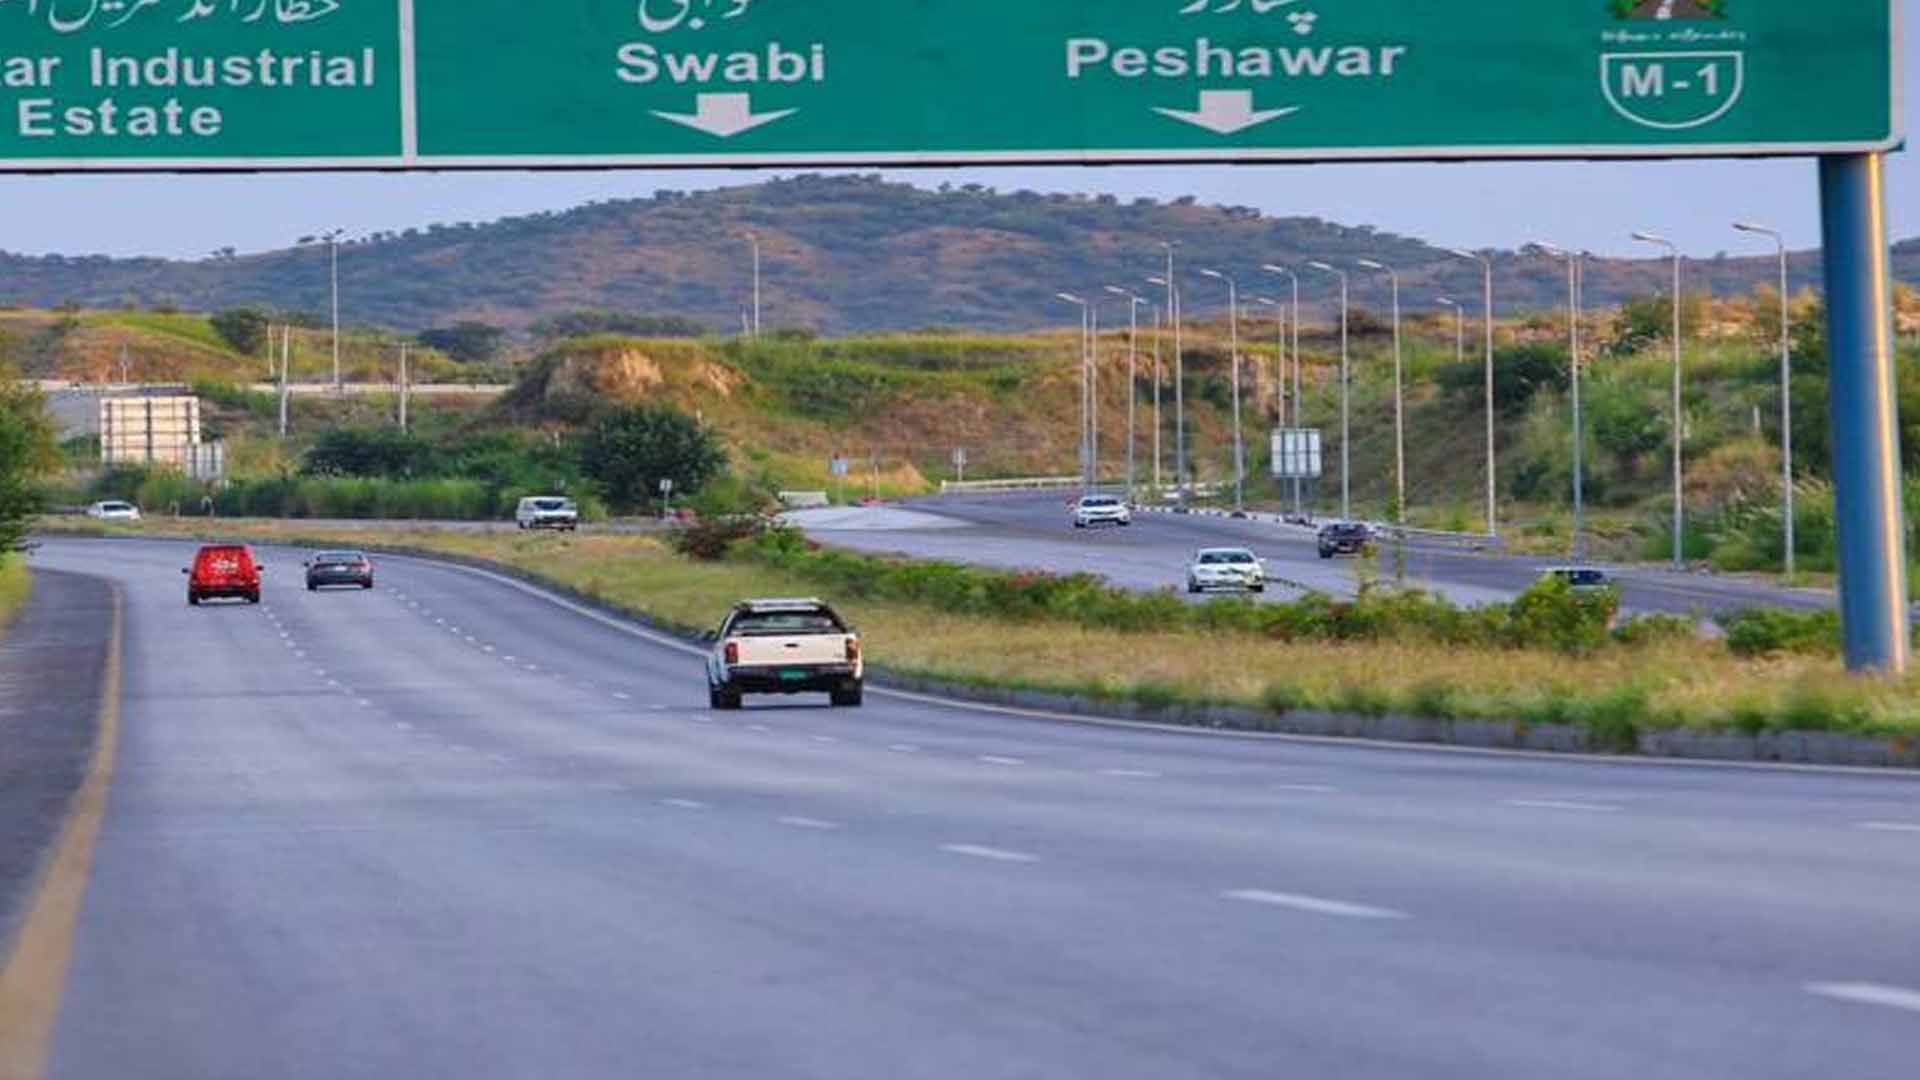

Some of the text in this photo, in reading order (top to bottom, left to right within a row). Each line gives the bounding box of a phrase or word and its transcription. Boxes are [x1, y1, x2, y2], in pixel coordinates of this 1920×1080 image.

[0, 47, 375, 87] ar Industrial
[616, 42, 825, 82] Swabi
[1065, 38, 1406, 77] Peshawar
[18, 98, 223, 136] Estate
